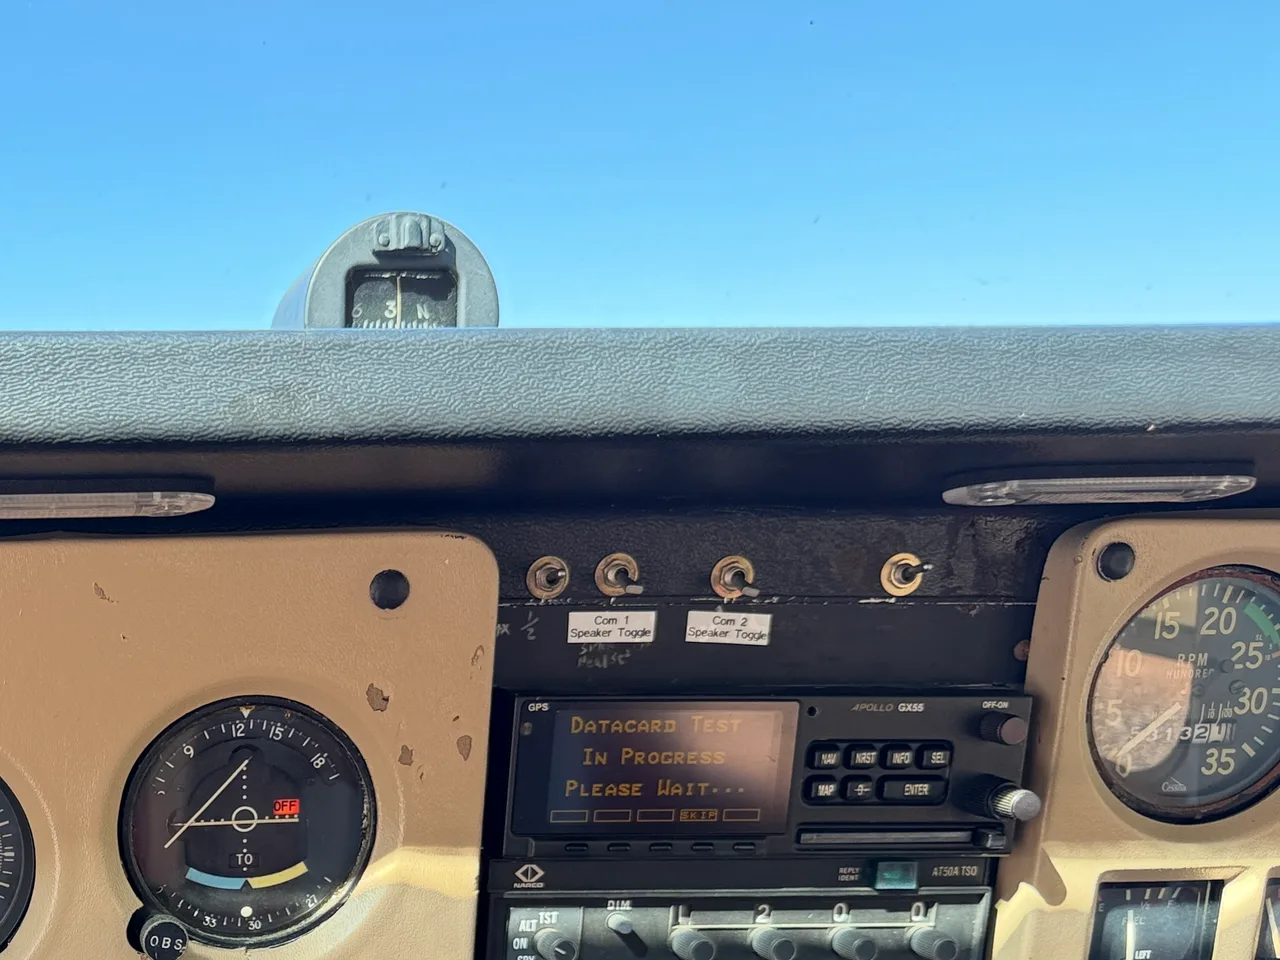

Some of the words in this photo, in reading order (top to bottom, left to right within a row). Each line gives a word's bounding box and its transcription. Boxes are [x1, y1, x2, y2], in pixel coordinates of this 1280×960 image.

[384, 300, 396, 318] 3
[594, 616, 617, 626] Com
[712, 616, 736, 626] Com
[740, 617, 748, 626] 2
[1154, 612, 1179, 639] 15
[1200, 607, 1236, 634] 20
[570, 628, 611, 638] Speaker
[618, 628, 651, 638] Toggle
[688, 628, 729, 639] Speaker
[735, 629, 768, 640] Toggle
[1177, 653, 1208, 666] RPM
[1231, 642, 1264, 669] 25
[1234, 688, 1267, 714] 30
[528, 703, 549, 712] GPS
[851, 704, 893, 712] APOLLO
[898, 704, 924, 712] GX55
[822, 753, 837, 764] NAV
[856, 752, 876, 764] NRST
[892, 752, 909, 764] INFO
[931, 752, 945, 763] SEL
[1201, 749, 1235, 775] 35
[818, 784, 834, 796] MAP
[904, 784, 929, 795] ENTER
[273, 801, 296, 811] OFF
[681, 811, 717, 820] SKIP
[236, 855, 252, 864] TO
[961, 866, 977, 876] TSO
[607, 901, 632, 910] DIM
[539, 912, 558, 924] TST
[519, 920, 538, 931] ALT
[150, 935, 182, 949] OBS
[513, 938, 527, 948] ON
[1135, 950, 1151, 960] LEFT
